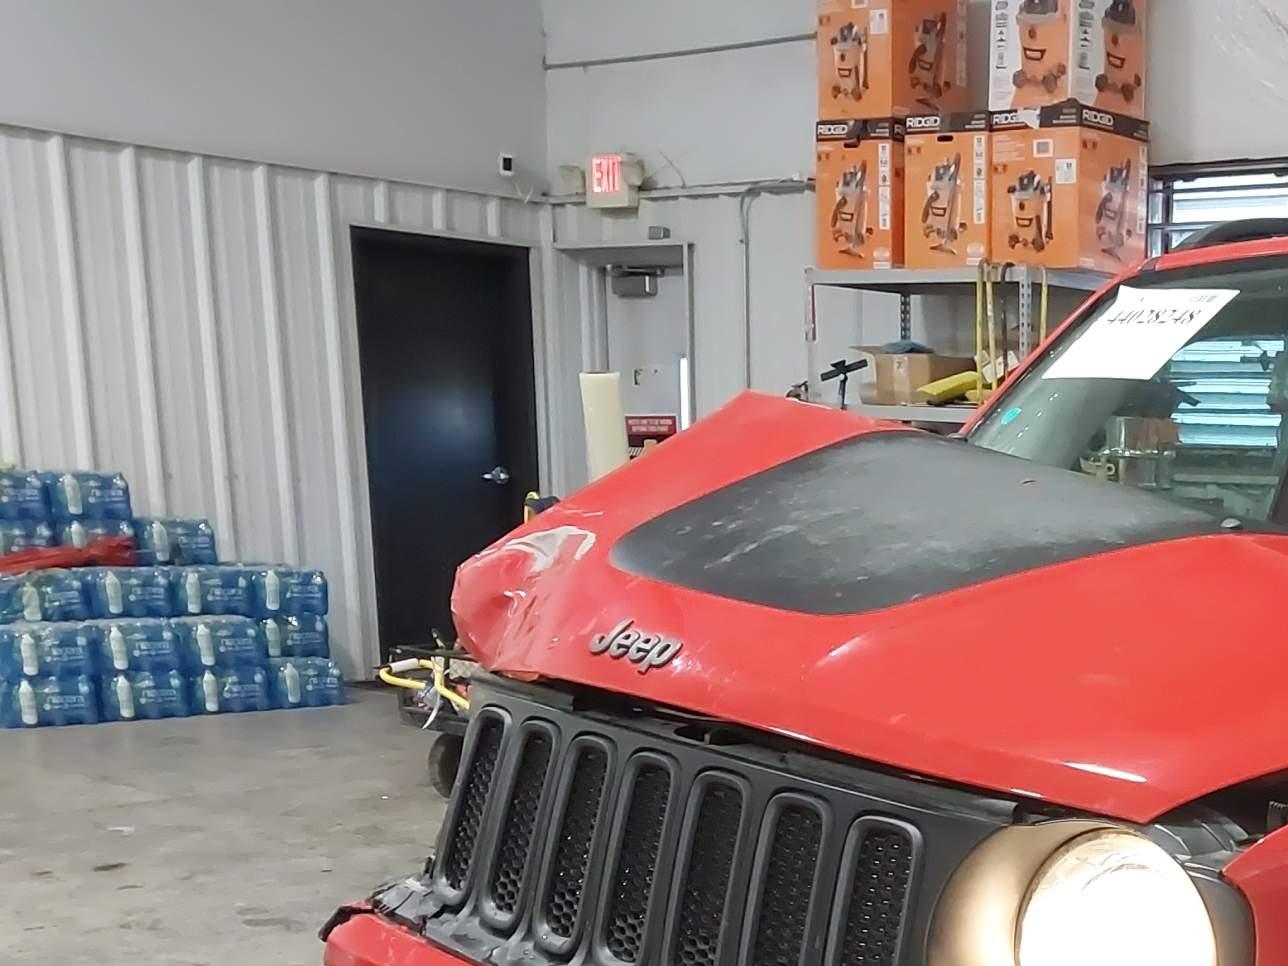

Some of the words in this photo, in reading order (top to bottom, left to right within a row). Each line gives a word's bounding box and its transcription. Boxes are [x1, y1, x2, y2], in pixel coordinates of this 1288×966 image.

[906, 116, 941, 128] RIDGID
[1082, 110, 1114, 126] RIDGID
[817, 124, 849, 135] RIDGID
[592, 156, 620, 192] EXIT
[590, 618, 683, 675] Jeep
